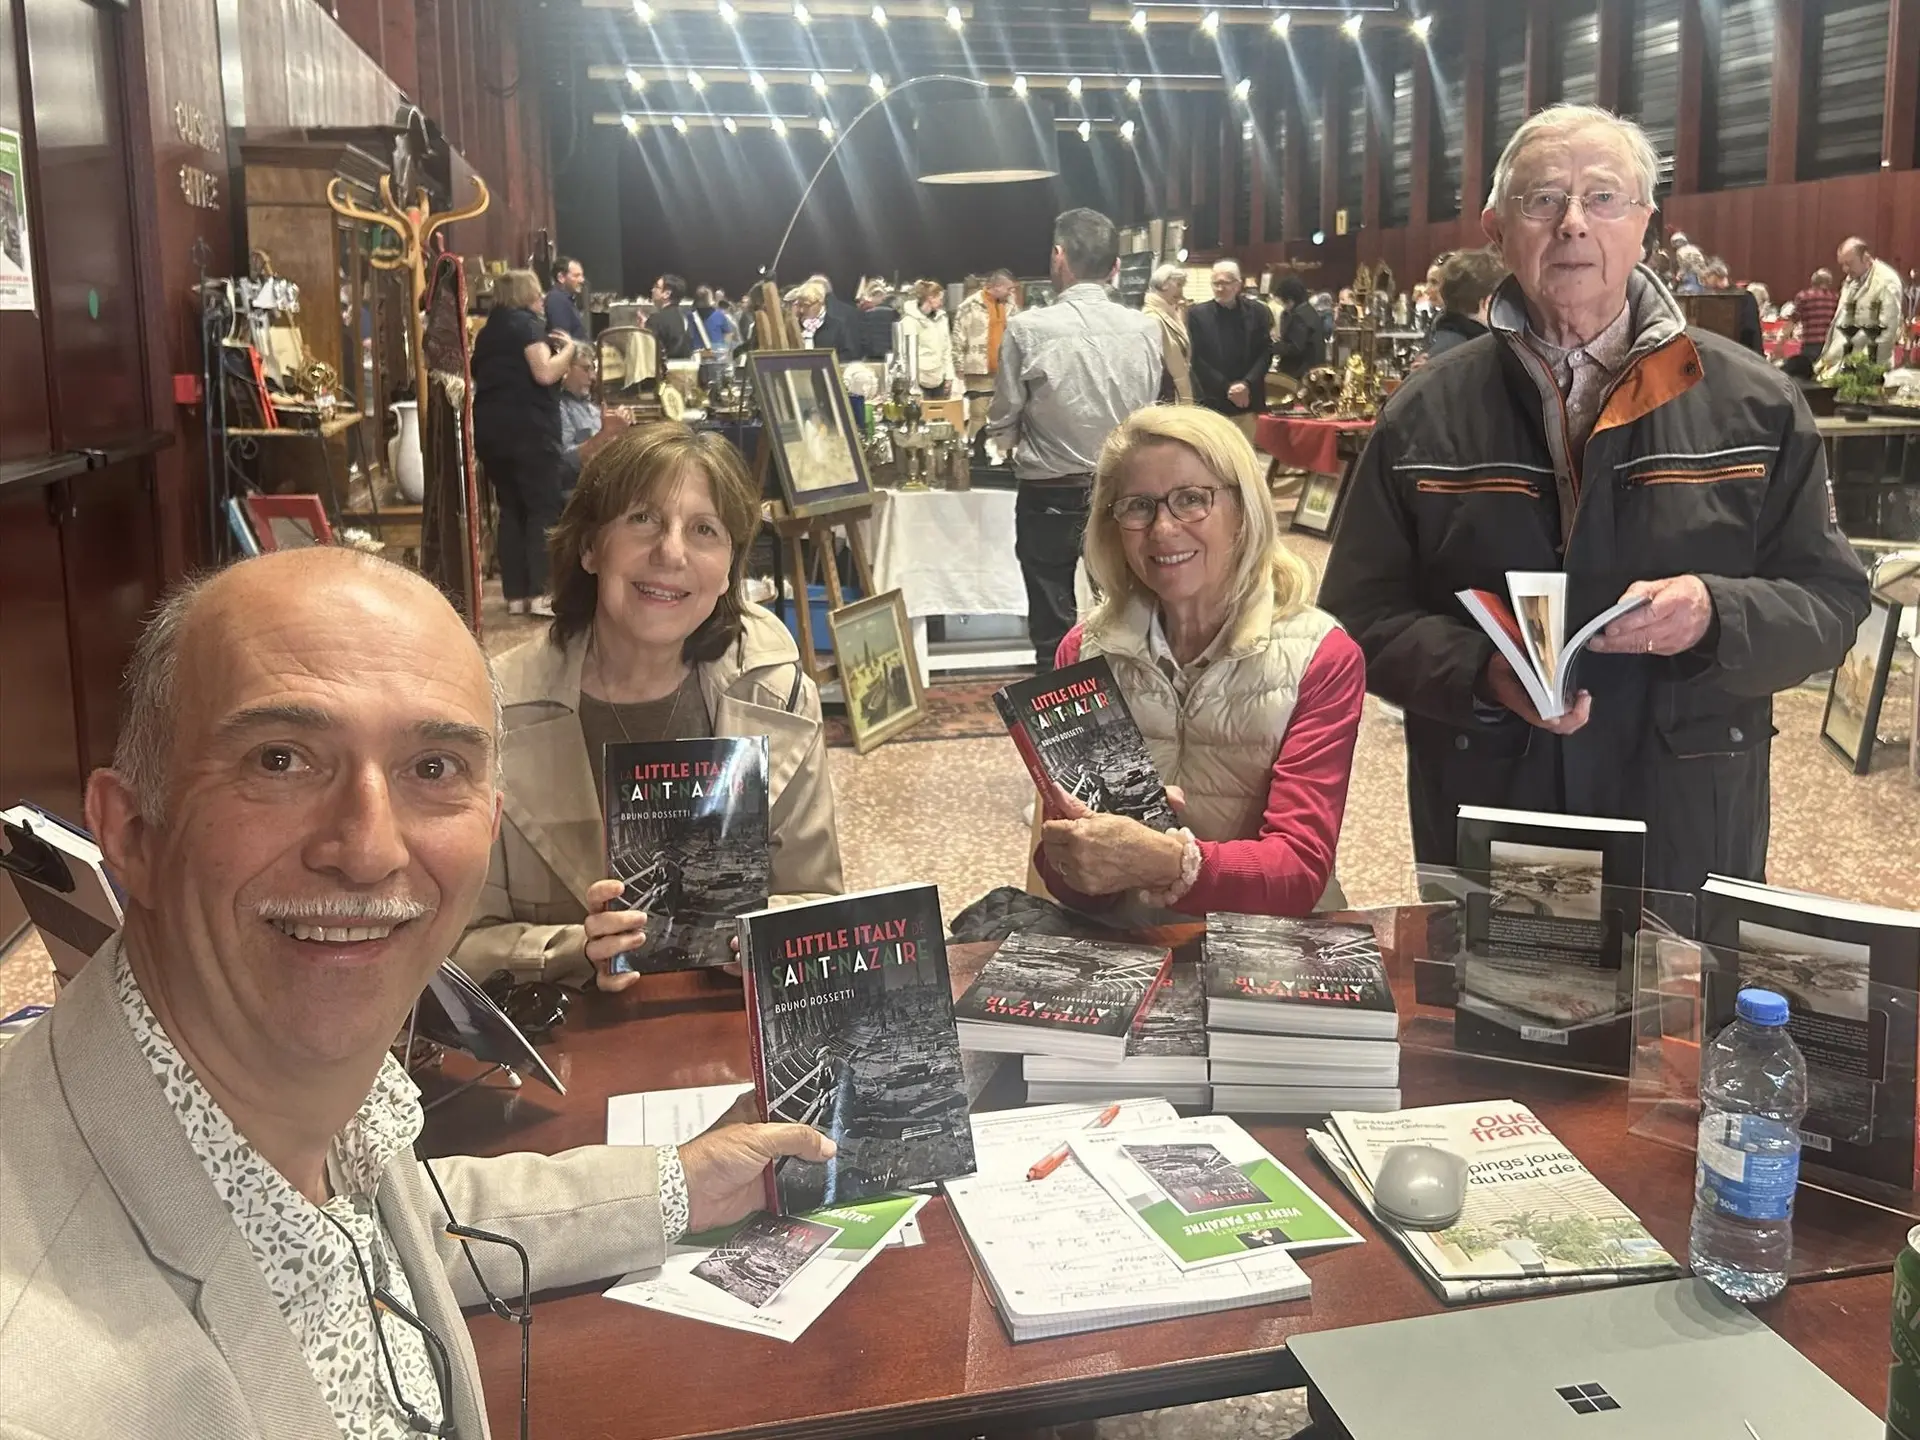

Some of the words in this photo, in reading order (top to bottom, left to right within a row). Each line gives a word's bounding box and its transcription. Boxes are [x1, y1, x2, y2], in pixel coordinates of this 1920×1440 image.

[1031, 688, 1069, 711] LITTLE
[1067, 677, 1098, 698] ITALY
[1060, 726, 1085, 741] ROSSETTI
[634, 762, 690, 780] LITTLE
[620, 811, 650, 821] BRUNO
[652, 809, 691, 820] ROSSETTI
[769, 947, 784, 962] LA
[784, 929, 849, 959] LITTLE
[853, 918, 908, 947] ITALY
[911, 920, 926, 936] DE
[771, 938, 930, 989] SAINT-NAZAIRE
[1241, 984, 1293, 997] ITALY
[1299, 990, 1361, 1003] LITTLE
[775, 998, 807, 1014] BRUNO
[810, 988, 855, 1007] ROSSETTI
[985, 1004, 1036, 1018] ITALY
[1040, 1011, 1100, 1026] LITTLE
[1468, 1157, 1525, 1175] pings
[1469, 1174, 1497, 1185] du
[1498, 1167, 1547, 1182] haut
[1549, 1163, 1576, 1175] de
[1244, 1211, 1263, 1222] DE
[1264, 1207, 1303, 1218] VIENT
[1182, 1214, 1245, 1236] PARAÎTRE
